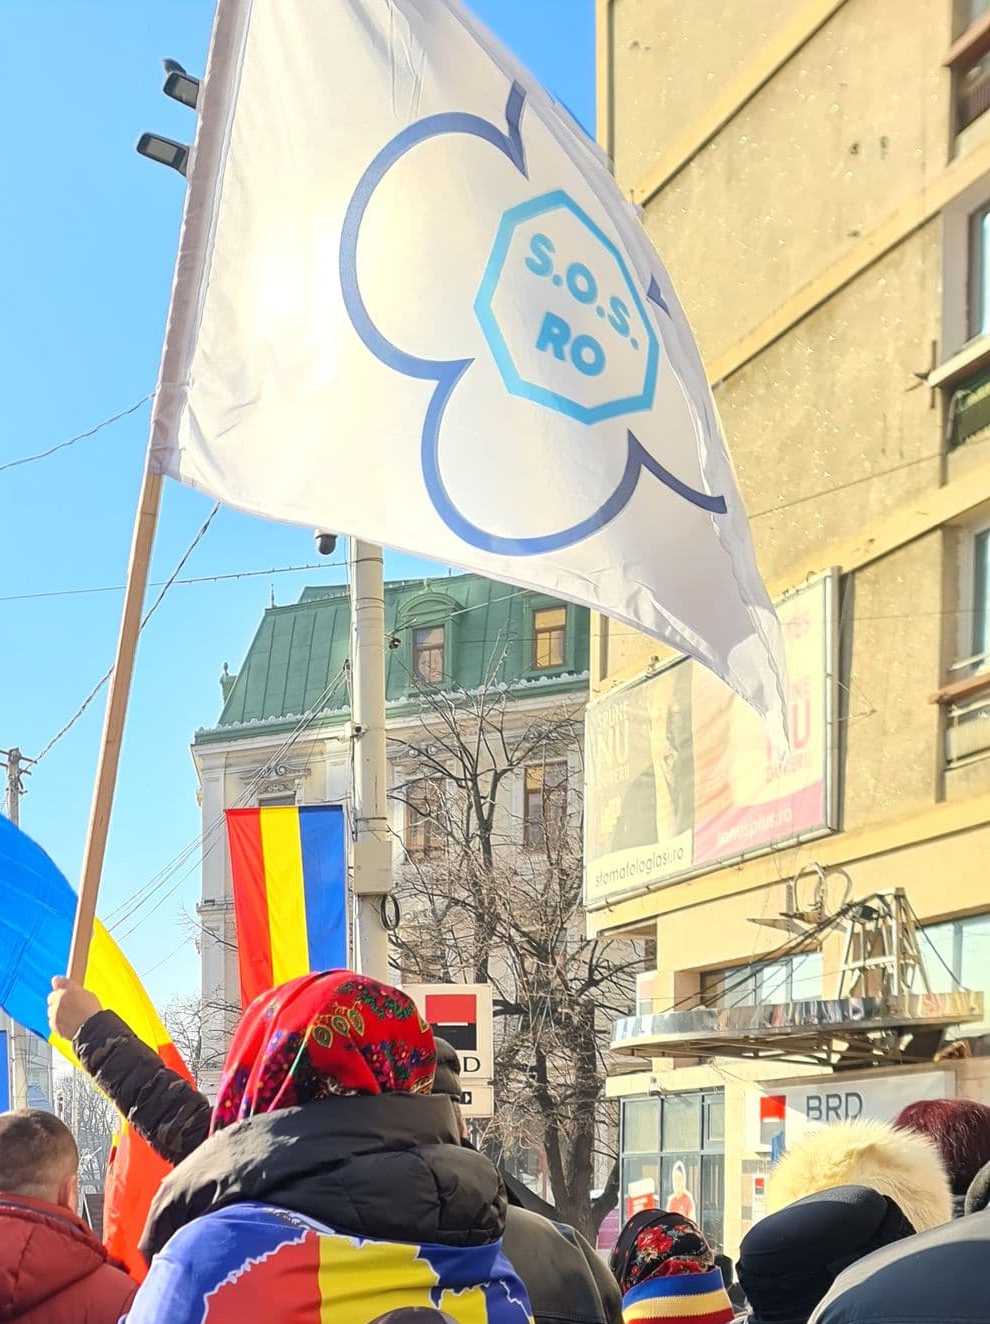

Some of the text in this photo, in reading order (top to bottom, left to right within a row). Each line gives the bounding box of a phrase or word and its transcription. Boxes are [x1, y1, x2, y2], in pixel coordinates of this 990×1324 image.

[525, 233, 639, 350] S.O.S.
[535, 311, 606, 376] RO
[806, 1092, 863, 1121] BRD
